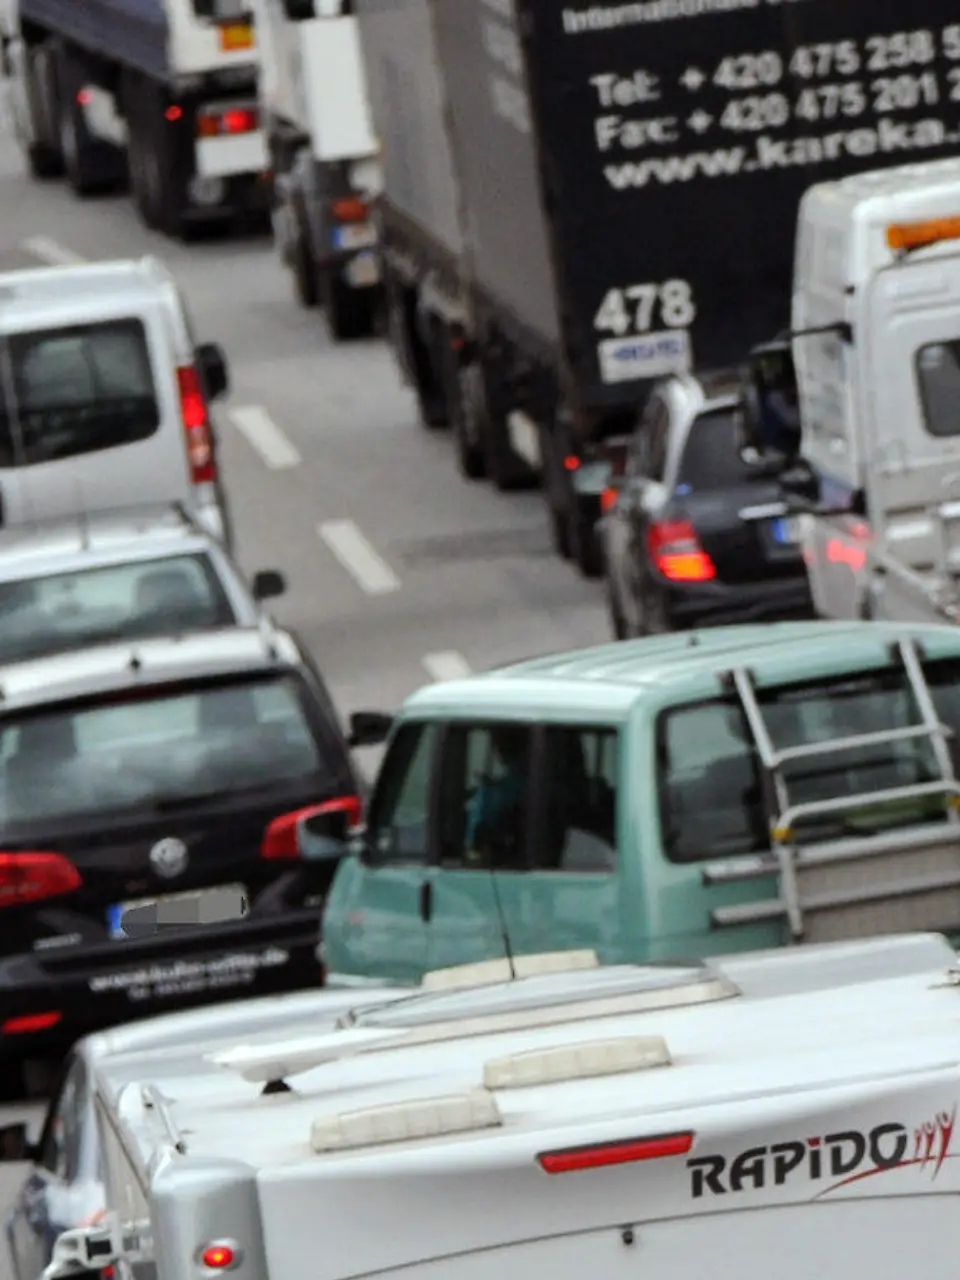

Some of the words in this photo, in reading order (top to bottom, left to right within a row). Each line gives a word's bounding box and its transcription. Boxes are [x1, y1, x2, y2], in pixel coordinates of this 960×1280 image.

[713, 51, 783, 90] 420
[789, 40, 860, 79] 475
[864, 29, 935, 71] 258
[720, 92, 789, 131] 420
[795, 81, 865, 121] 475
[870, 70, 939, 112] 201
[593, 278, 696, 336] 478
